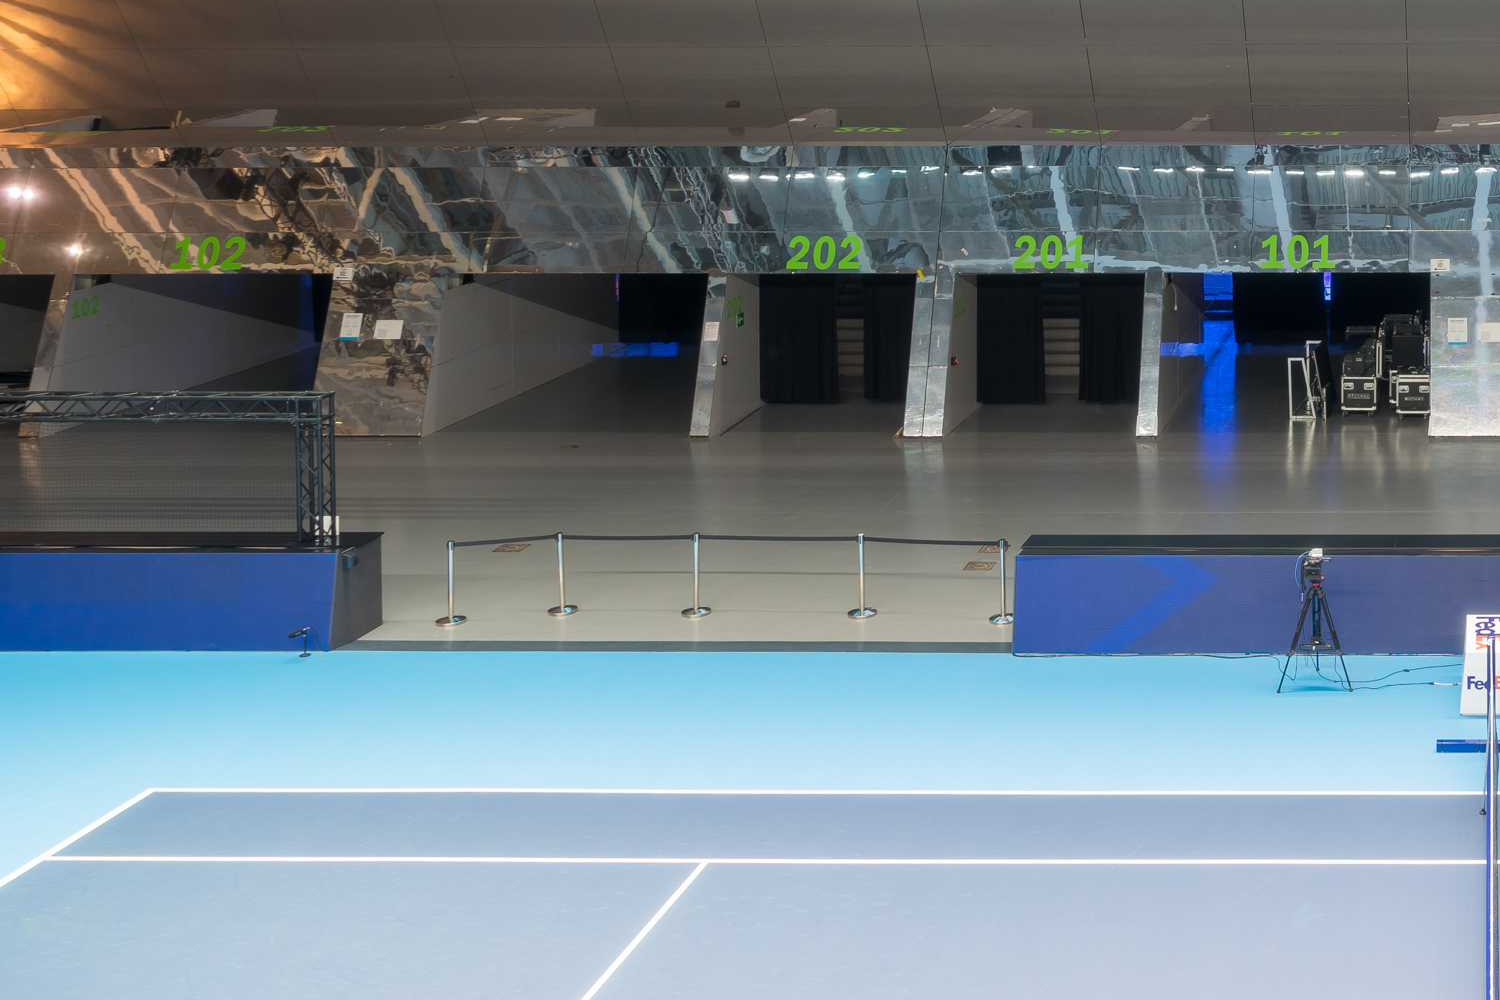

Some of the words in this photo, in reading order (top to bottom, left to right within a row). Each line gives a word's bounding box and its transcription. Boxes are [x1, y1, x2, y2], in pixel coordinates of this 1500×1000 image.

[170, 236, 246, 270] 102
[786, 235, 863, 270] 202
[1013, 235, 1089, 269] 201
[1261, 234, 1336, 269] 101
[71, 296, 99, 319] 102
